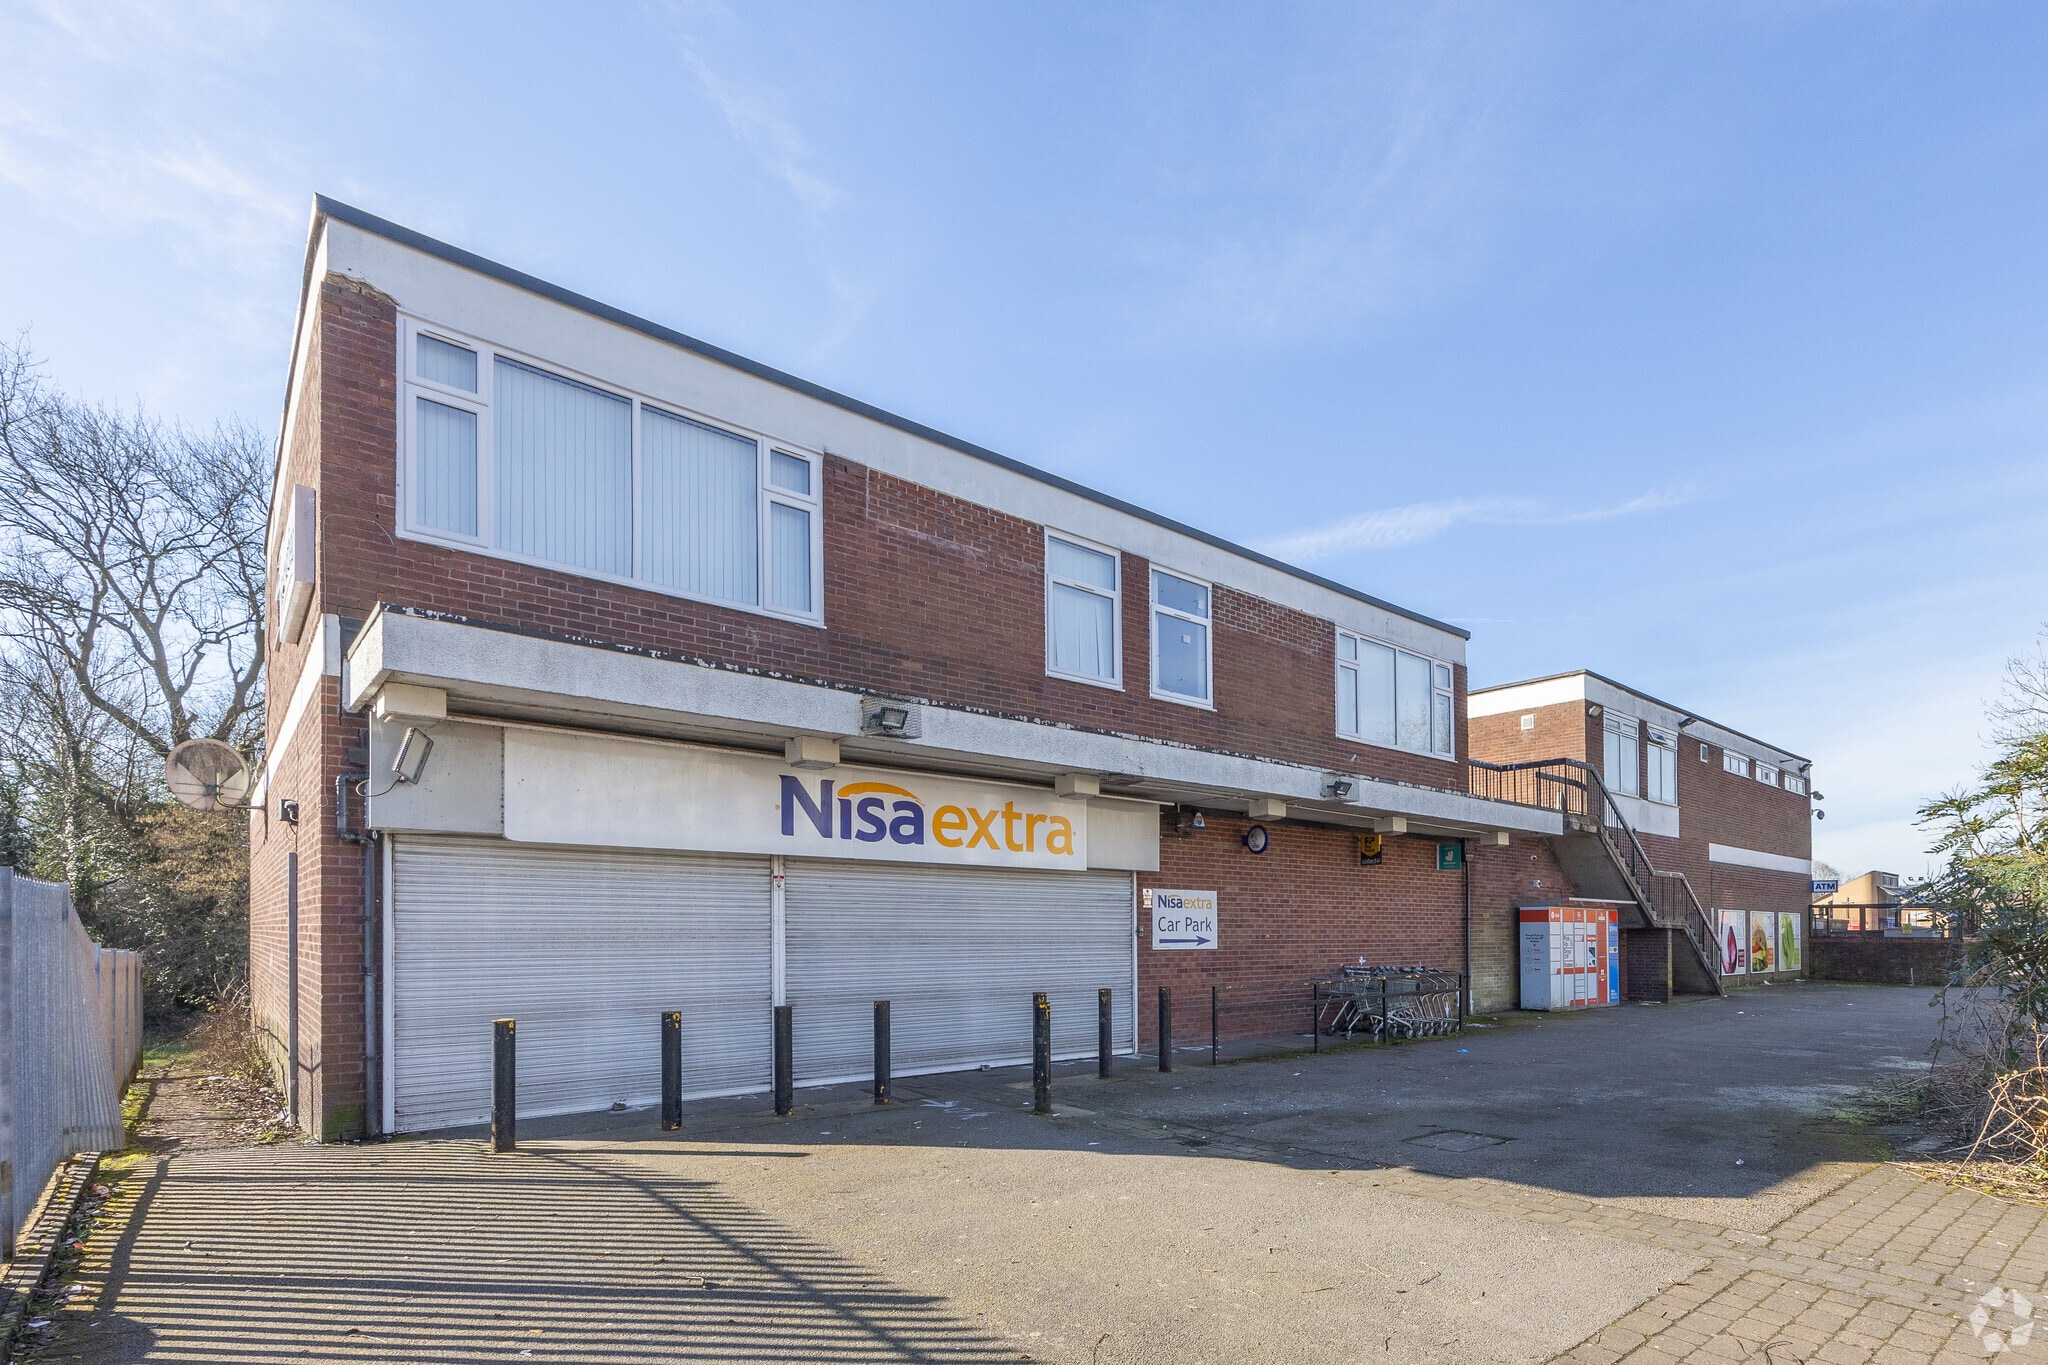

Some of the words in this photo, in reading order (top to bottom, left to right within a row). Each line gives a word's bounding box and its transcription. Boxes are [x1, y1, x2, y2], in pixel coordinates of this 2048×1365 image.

[1815, 883, 1836, 891] ATM
[1158, 916, 1181, 932] Car
[1185, 916, 1213, 932] Park
